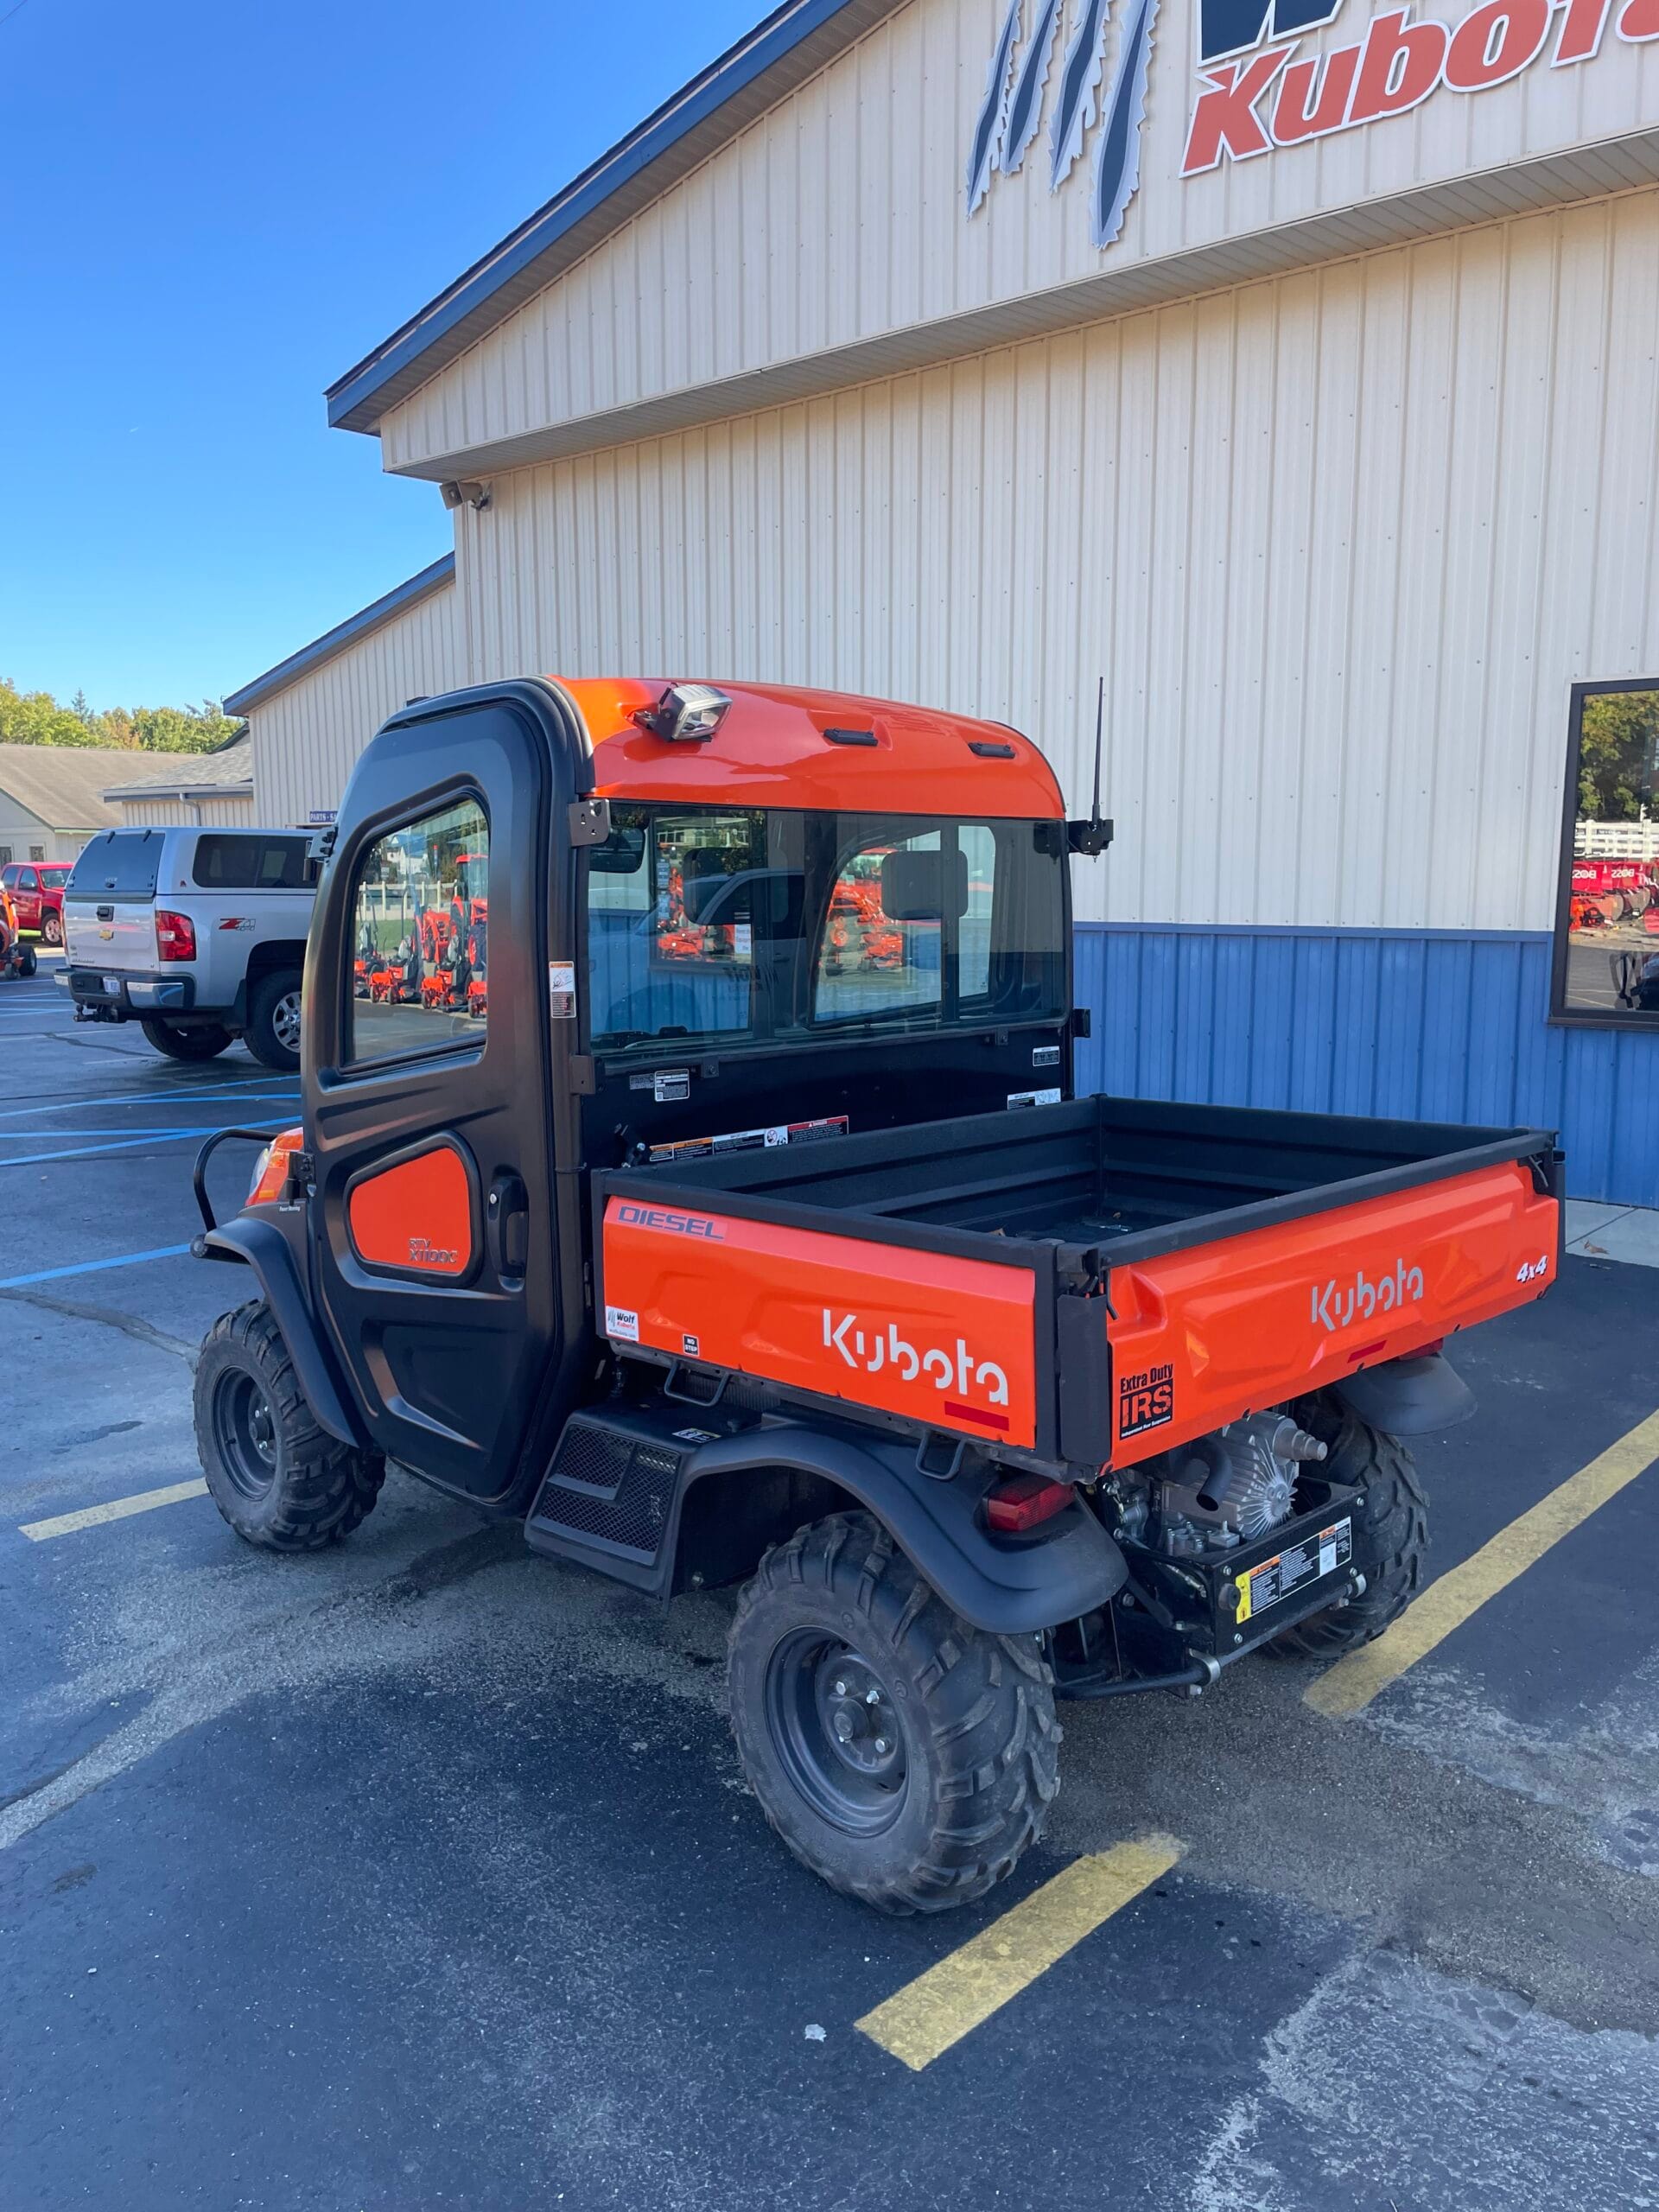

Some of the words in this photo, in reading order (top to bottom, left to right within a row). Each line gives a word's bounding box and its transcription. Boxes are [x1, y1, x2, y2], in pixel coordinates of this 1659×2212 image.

[1180, 0, 1659, 178] Kubot
[618, 1205, 724, 1240] DIESEL
[409, 1237, 431, 1249] RTV
[1516, 1255, 1548, 1283] 4x4
[1311, 1258, 1424, 1332] Kubota
[616, 1313, 635, 1324] Wolf
[823, 1308, 1009, 1406] Kubota
[1120, 1373, 1147, 1394] Extra
[1150, 1363, 1173, 1382] Duty
[1122, 1384, 1172, 1427] IRS
